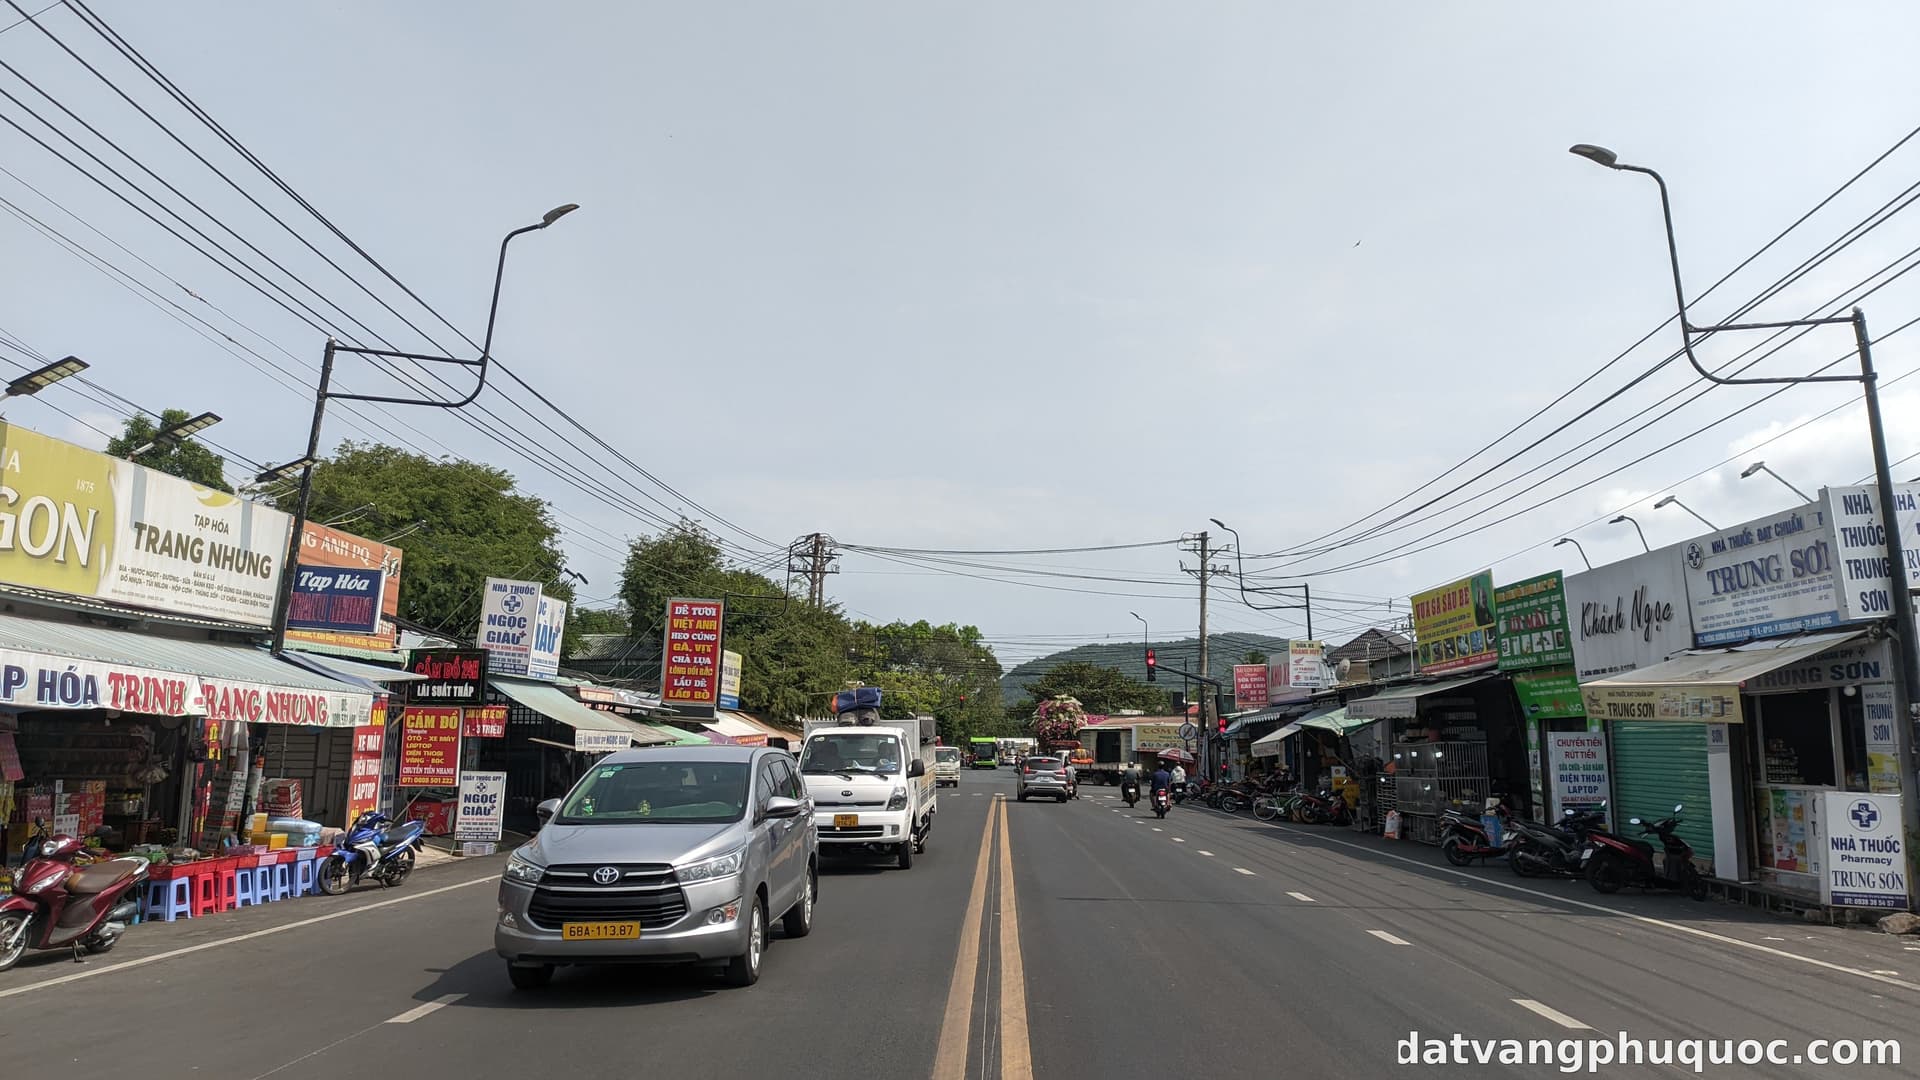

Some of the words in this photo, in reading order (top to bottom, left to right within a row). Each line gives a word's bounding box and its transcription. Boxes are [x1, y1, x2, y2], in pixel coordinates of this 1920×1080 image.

[76, 480, 94, 494] 1875
[1842, 490, 1872, 515] NHÀ
[194, 514, 210, 532] TẠP
[212, 517, 230, 535] HÓA
[1840, 518, 1885, 548] THUỐC
[1712, 536, 1727, 554] NHÀ
[1728, 527, 1754, 548] THUỐC
[1757, 526, 1774, 543] ĐẠT
[1774, 513, 1804, 537] CHUẨN
[134, 521, 204, 564] TRANG
[208, 541, 272, 580] NHUNG
[321, 536, 349, 556] ANH
[352, 543, 370, 566] PQ
[1707, 554, 1782, 595] TRUNG
[1845, 557, 1892, 580] TRUNG
[300, 571, 332, 592] Tạp
[335, 574, 370, 590] Hóa
[492, 584, 508, 593] NHÀ
[510, 584, 535, 596] THUỐC
[1860, 589, 1890, 612] SƠN
[692, 607, 716, 616] TƯƠI
[1580, 596, 1625, 641] Khánh
[1630, 585, 1673, 643] Ngọc
[488, 614, 527, 631] NGỌC
[674, 617, 694, 630] VIỆT
[696, 620, 716, 630] ANH
[672, 632, 690, 640] HEO
[695, 644, 712, 654] VỊT
[416, 655, 442, 679] CẦM
[1830, 661, 1880, 680] SƠN
[674, 676, 692, 686] LẨU
[37, 664, 98, 705] HÓA
[108, 672, 186, 715] TRINH
[266, 691, 328, 725] NHUNG
[417, 684, 430, 697] LÃI
[432, 682, 452, 698] SUẤT
[453, 682, 474, 698] THẤP
[669, 688, 690, 698] LẨU
[1607, 703, 1636, 718] TRUNG
[1637, 700, 1654, 718] SƠN
[1866, 704, 1892, 720] TRUNG
[406, 710, 436, 730] CẦM
[440, 712, 458, 730] ĐỒ
[482, 724, 502, 735] TRIỆU
[1873, 724, 1890, 741] SƠN
[358, 734, 366, 752] XE
[367, 732, 381, 752] MÁY
[1557, 736, 1585, 747] CHUYỂN
[1586, 736, 1602, 747] TIỀN
[1565, 750, 1580, 759] RÚT
[1580, 750, 1596, 760] TIỀN
[354, 756, 366, 780] ĐIỆN
[402, 764, 424, 774] CHUYỂN
[424, 765, 436, 775] TIỀN
[436, 767, 454, 776] NHANH
[1560, 774, 1579, 784] ĐIỆN
[1582, 774, 1605, 785] THOẠI
[354, 782, 376, 800] LAPTOP
[1568, 786, 1598, 794] LAPTOP
[464, 793, 496, 805] NGỌC
[1831, 834, 1856, 852] NHÀ
[1860, 834, 1900, 854] THUỐC
[1841, 854, 1892, 866] Pharmacy
[1832, 870, 1876, 888] TRUNG
[1880, 870, 1904, 890] SƠN
[569, 925, 633, 937] 68A-113.87
